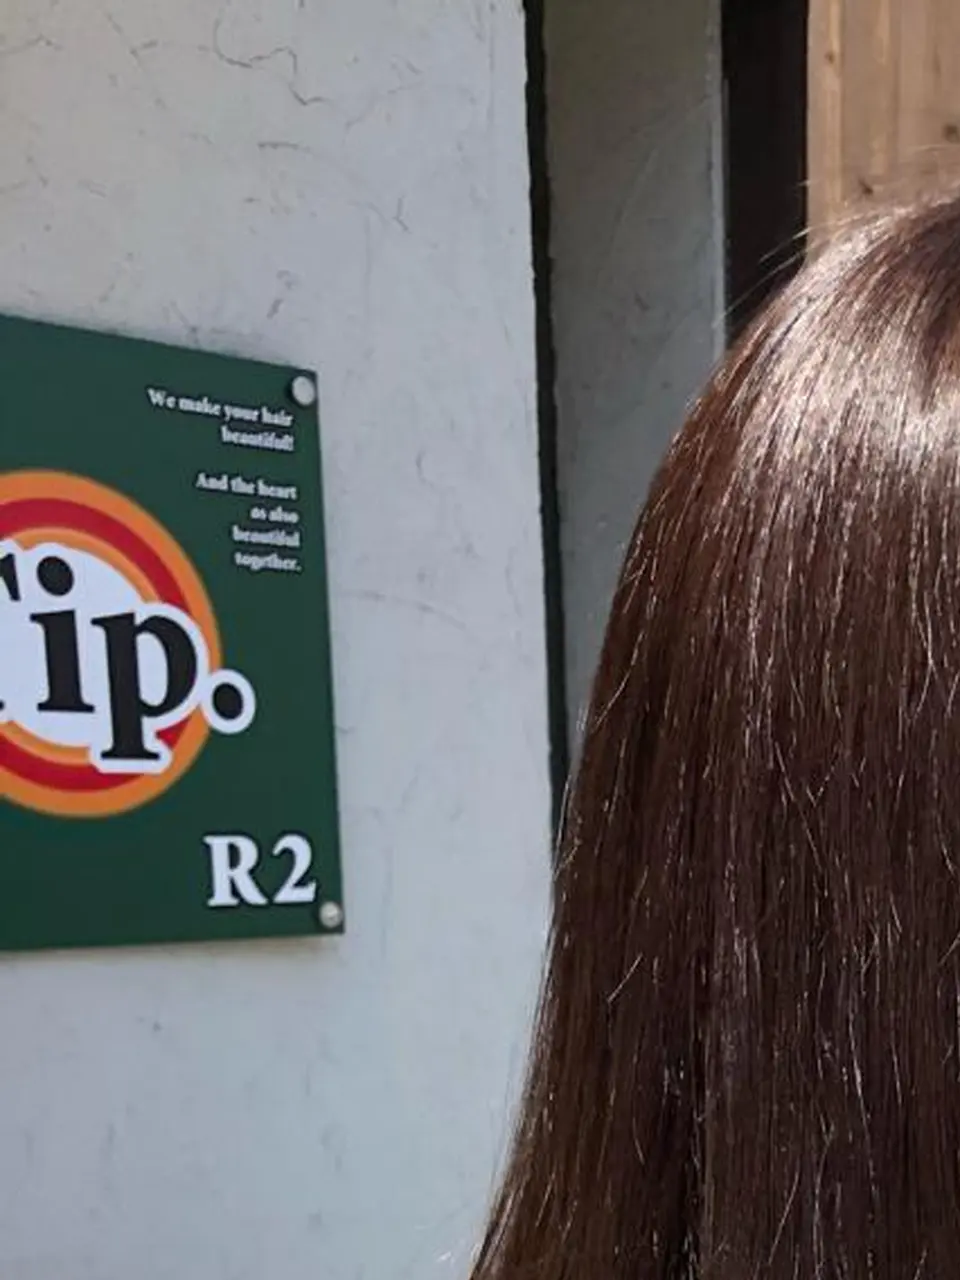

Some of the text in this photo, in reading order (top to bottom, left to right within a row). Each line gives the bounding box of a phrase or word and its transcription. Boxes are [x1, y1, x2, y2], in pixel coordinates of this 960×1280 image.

[148, 387, 294, 427] We make your hair
[196, 472, 297, 500] And the heart
[268, 506, 299, 523] also
[232, 524, 300, 547] beautiful
[234, 551, 302, 572] together.
[202, 834, 317, 907] R2
